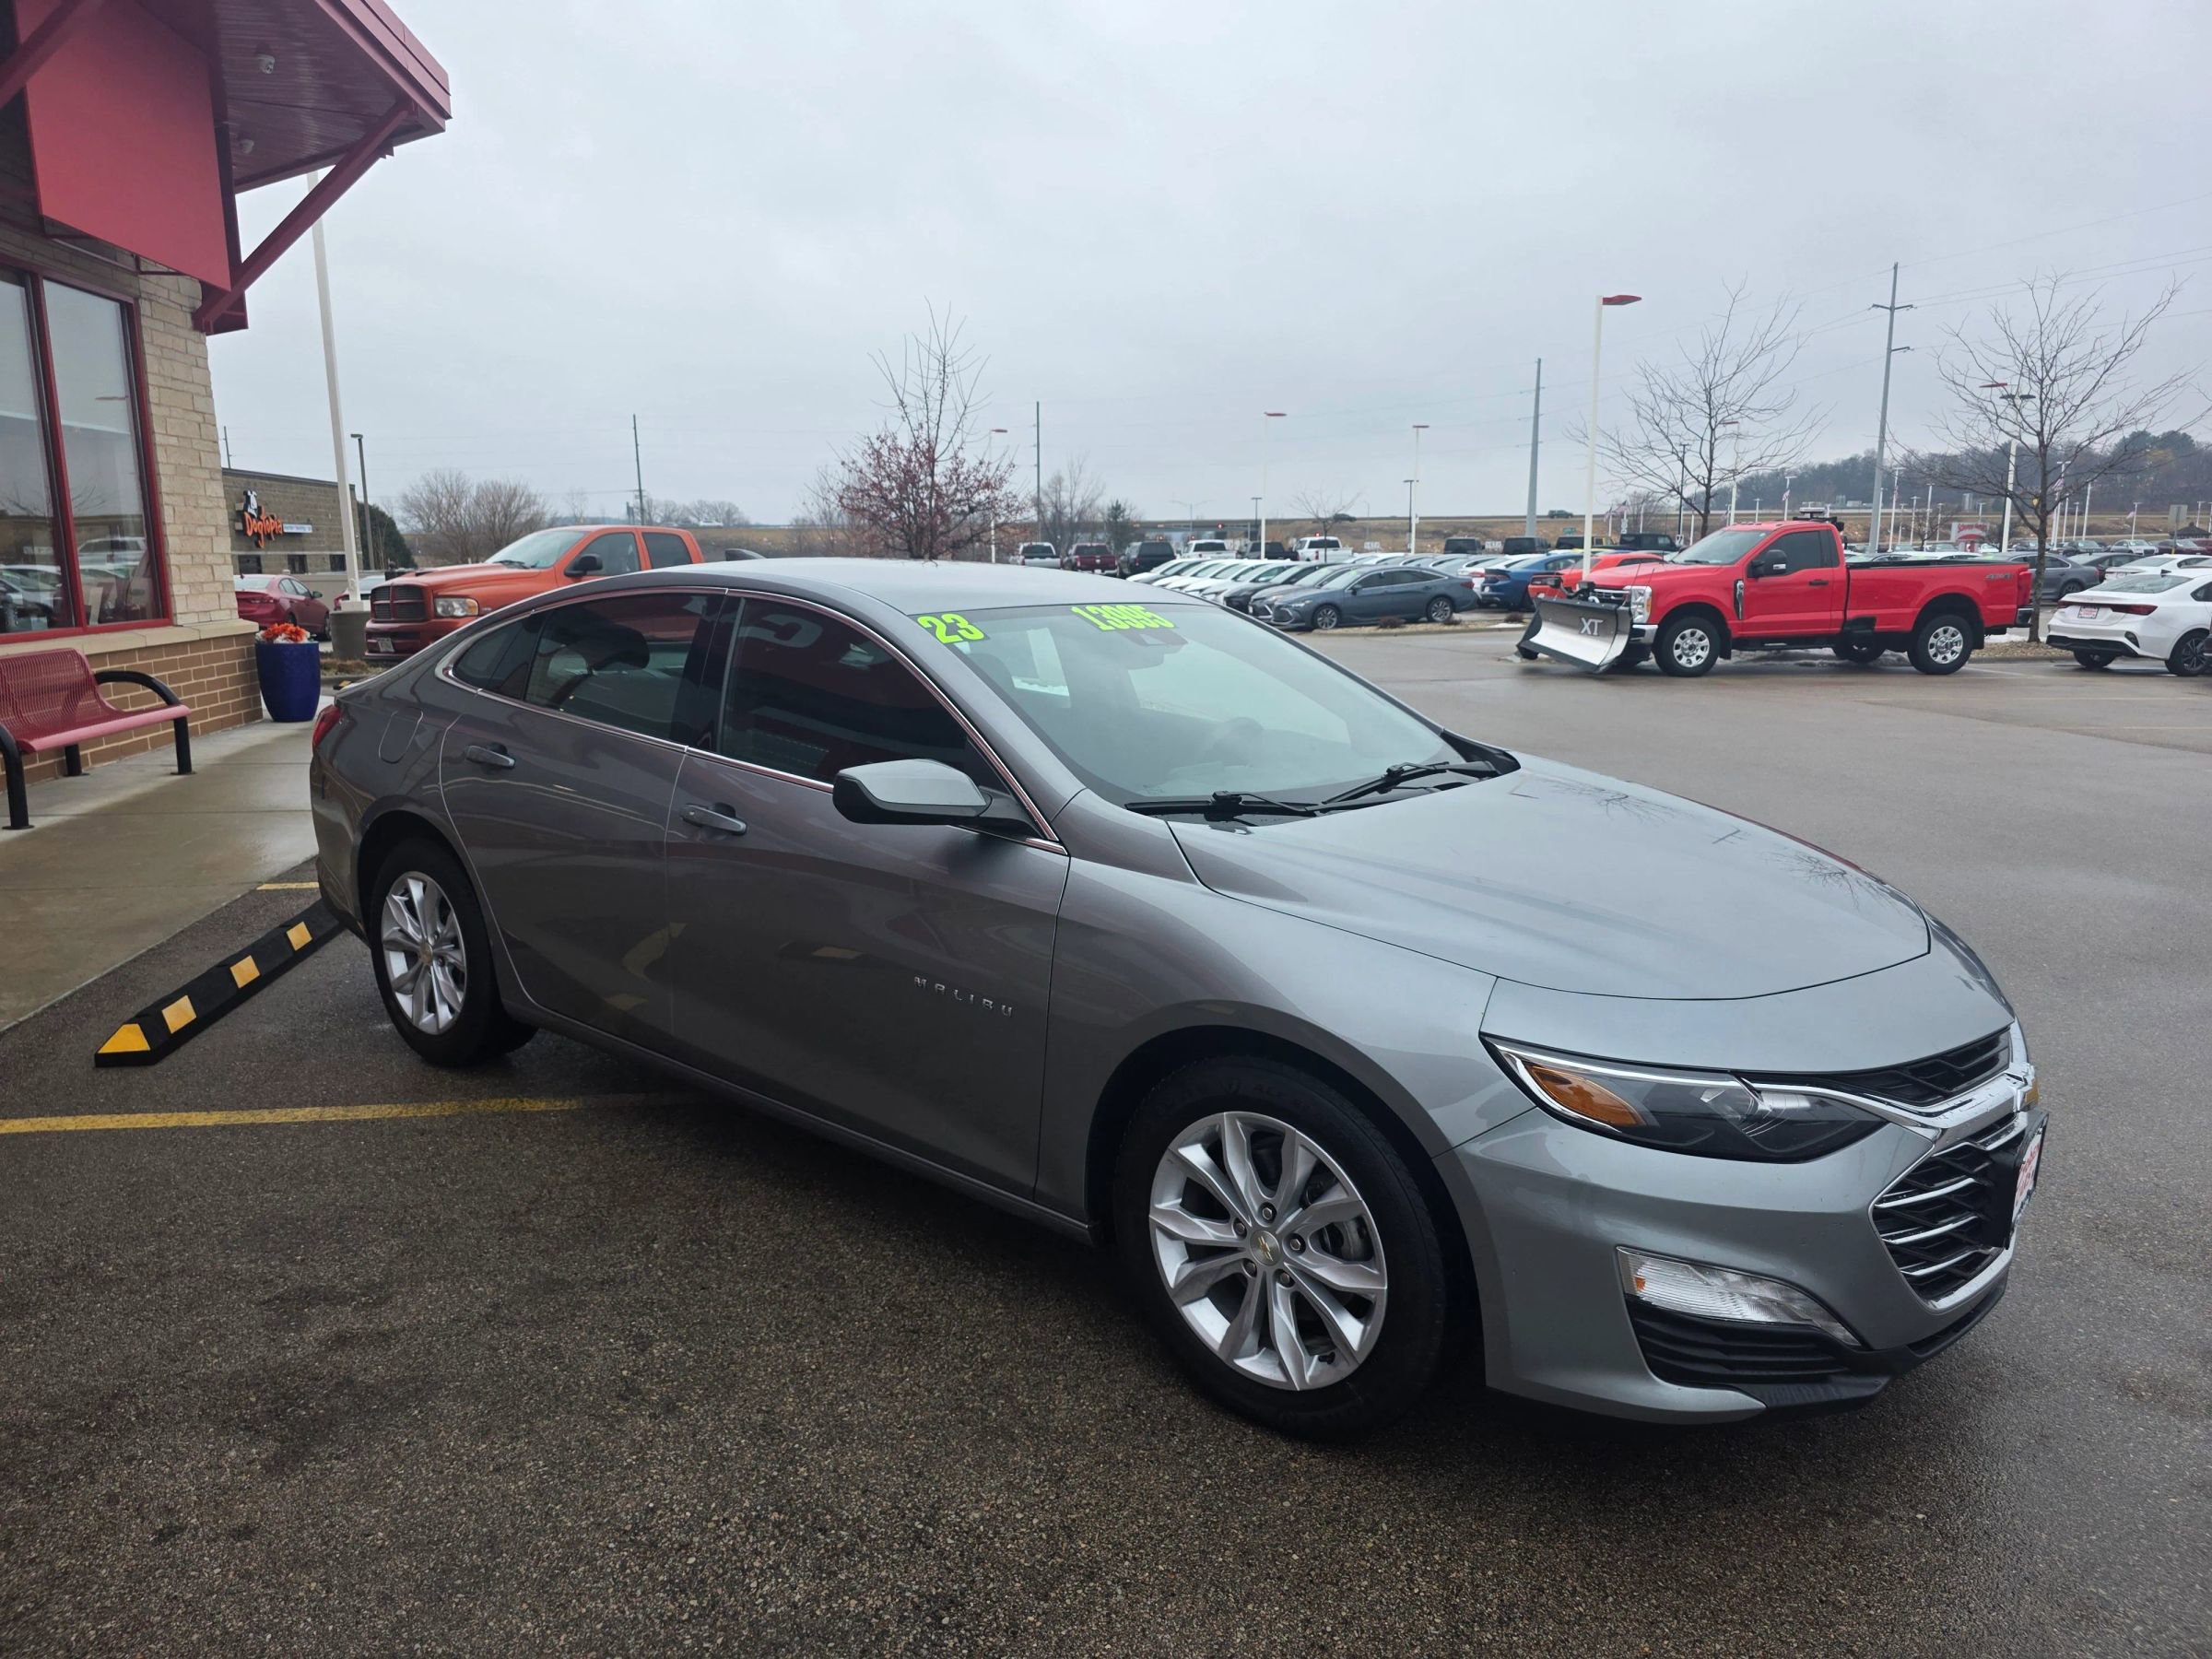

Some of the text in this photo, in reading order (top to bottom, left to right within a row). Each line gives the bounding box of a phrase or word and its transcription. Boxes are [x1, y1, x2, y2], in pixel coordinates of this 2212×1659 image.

[244, 506, 283, 548] Dogtopia
[916, 613, 985, 643] 23
[1581, 617, 1604, 636] XT
[913, 975, 1013, 1018] MALIBU
